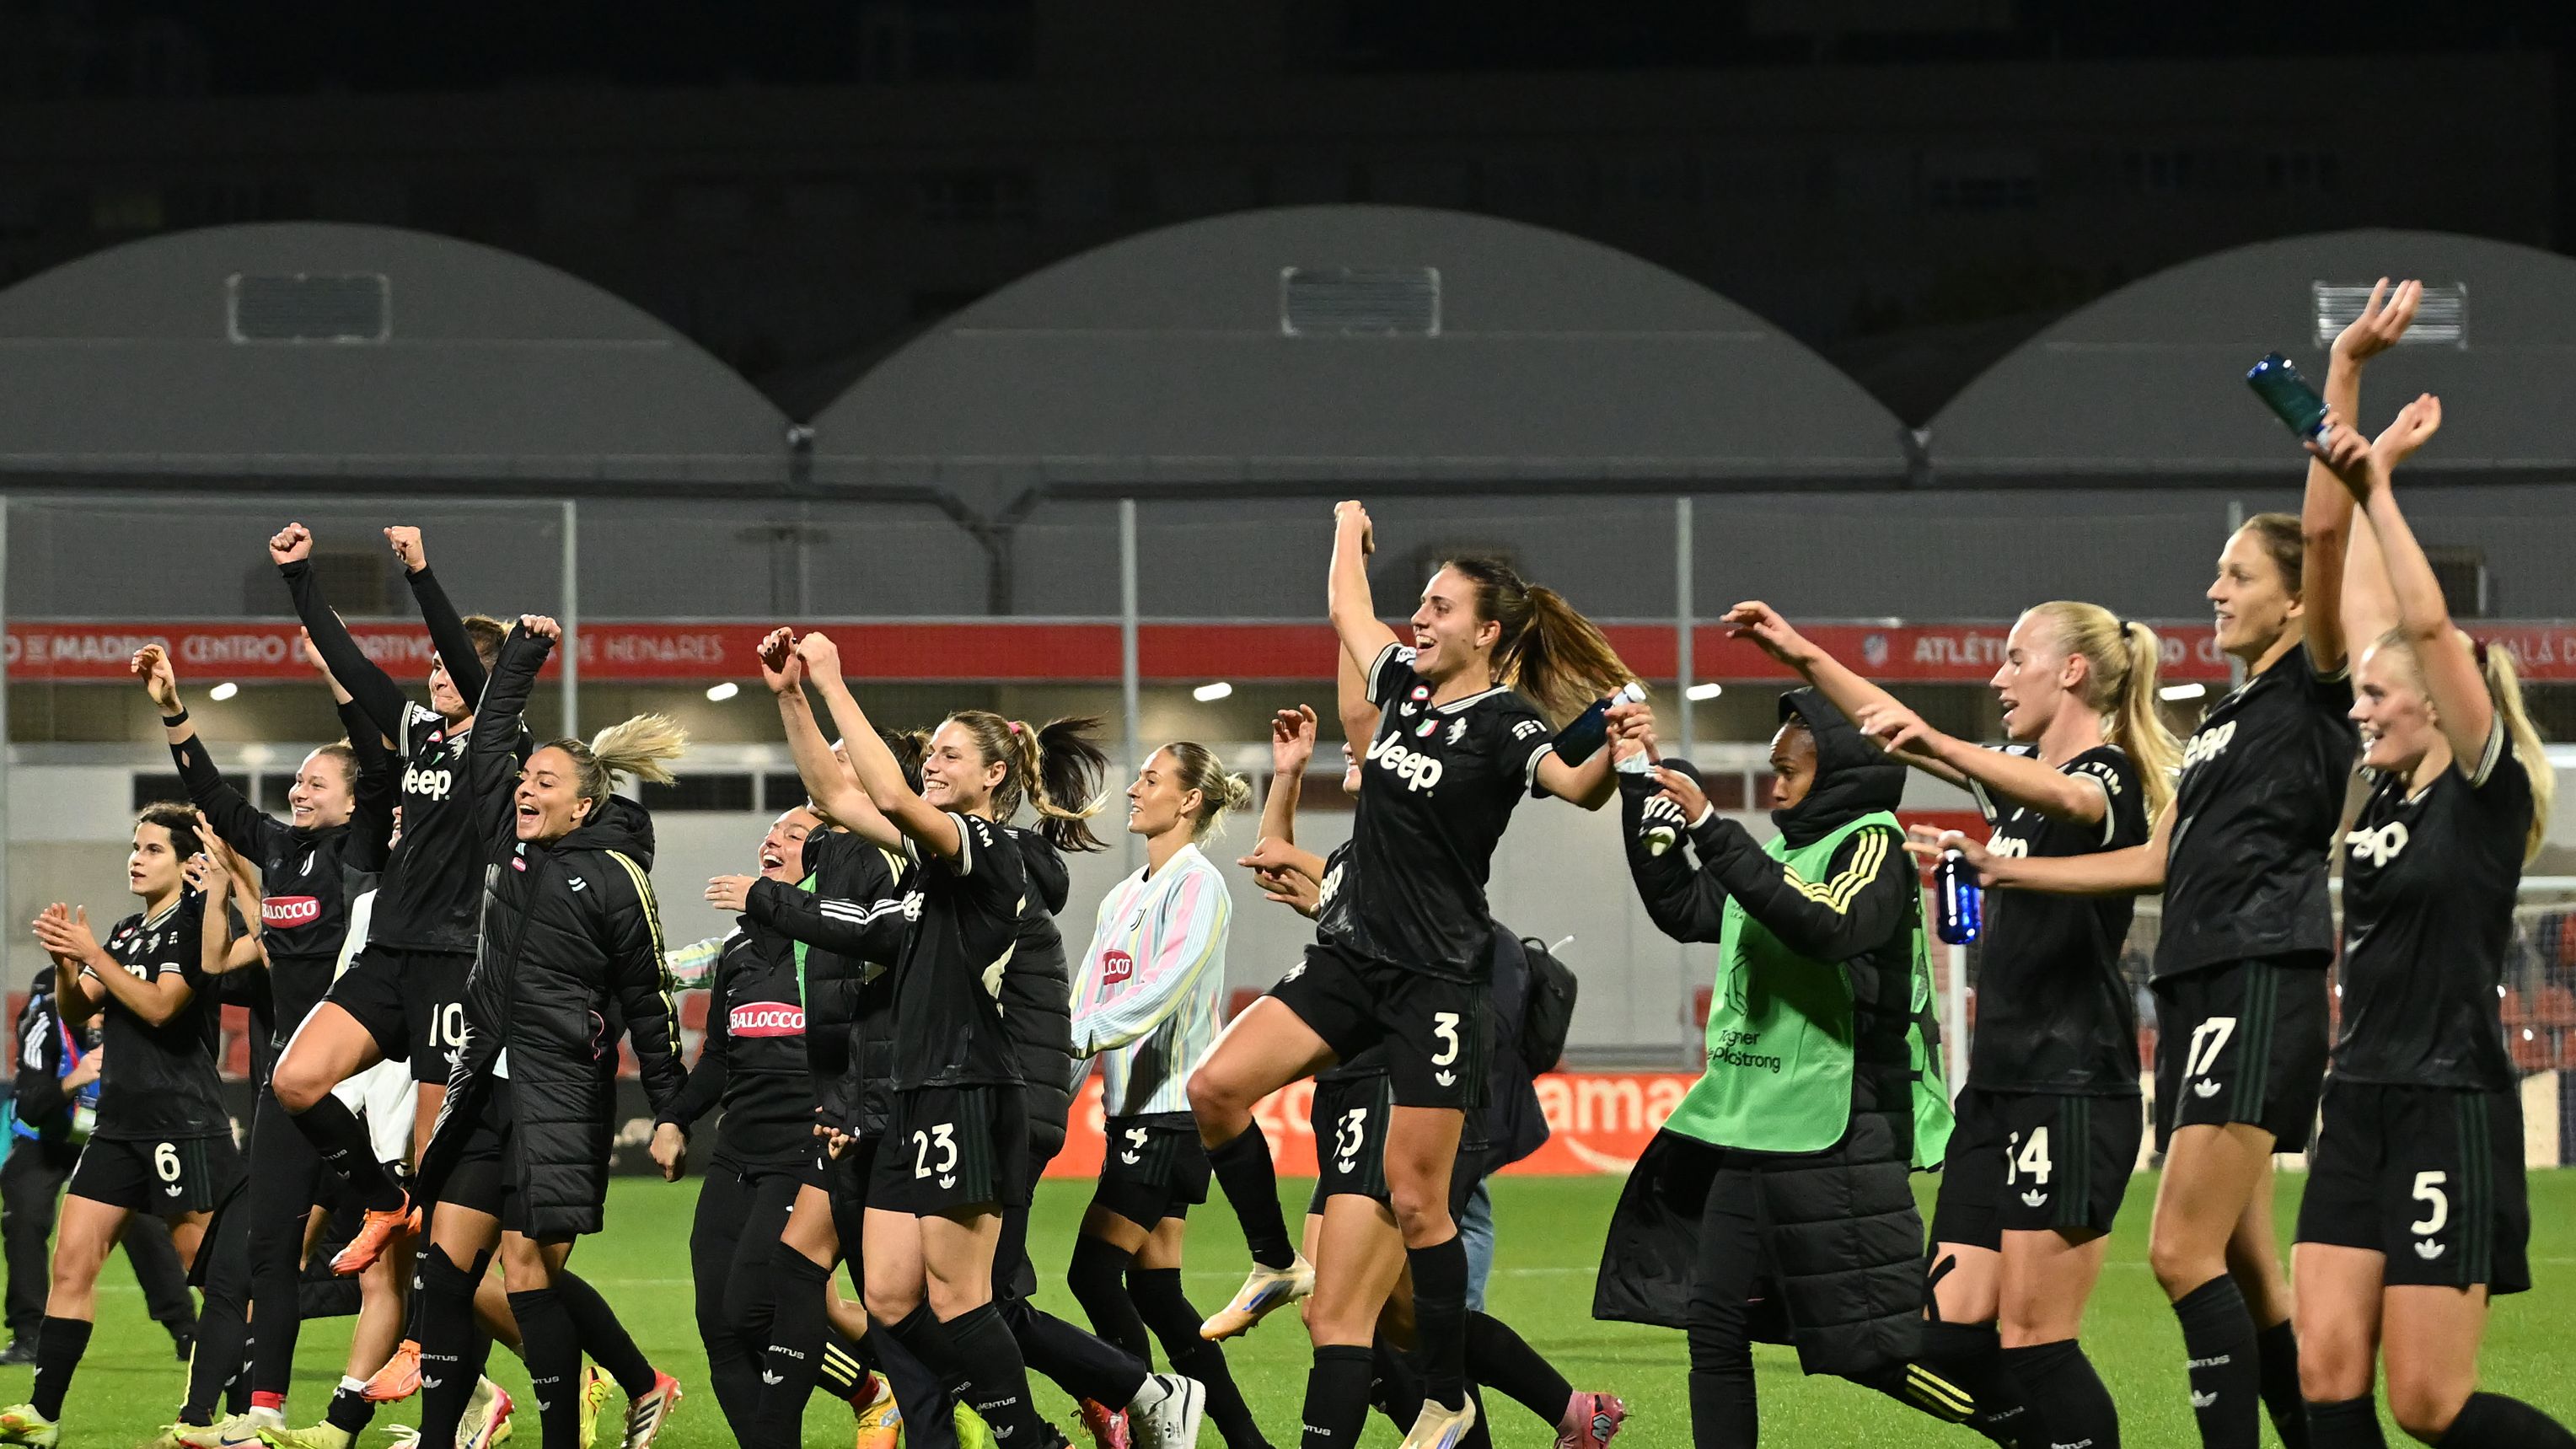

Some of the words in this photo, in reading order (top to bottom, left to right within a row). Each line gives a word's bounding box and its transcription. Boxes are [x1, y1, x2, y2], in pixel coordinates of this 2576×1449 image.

[180, 634, 287, 664] CENTRO
[1366, 730, 1443, 792] Jeep
[2182, 720, 2237, 769] eep
[2092, 761, 2123, 796] TIM
[969, 815, 994, 849] TIM
[428, 1001, 466, 1047] 10
[730, 1011, 806, 1029] BALOCCO
[1431, 1012, 1460, 1066] 3
[2184, 1017, 2237, 1079] 17
[1536, 1078, 1701, 1133] ama
[154, 1142, 181, 1182] 6
[912, 1122, 958, 1179] 23
[2410, 1170, 2449, 1236] 5
[421, 1352, 459, 1362] ENTUS
